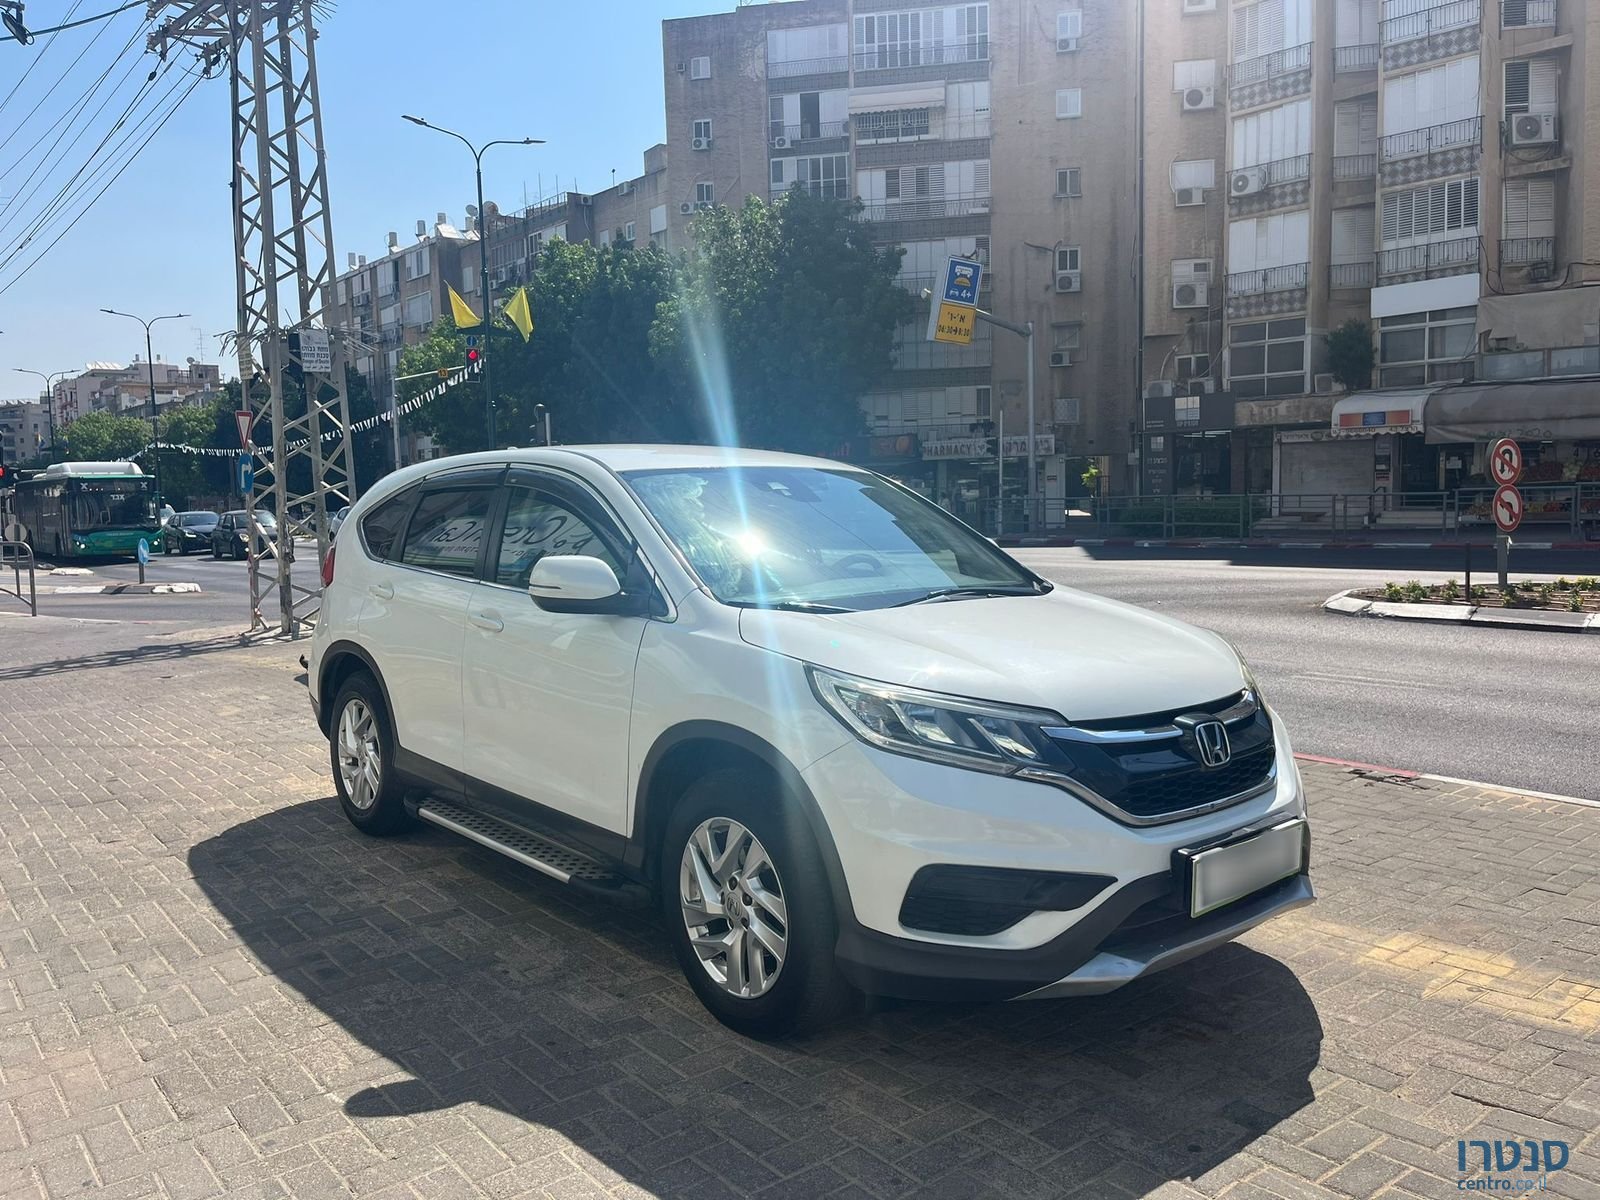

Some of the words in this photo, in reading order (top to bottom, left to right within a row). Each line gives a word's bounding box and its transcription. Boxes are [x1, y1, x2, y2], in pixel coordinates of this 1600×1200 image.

[960, 289, 972, 298] 4+
[438, 369, 447, 377] 13
[923, 443, 971, 456] PHARMACY
